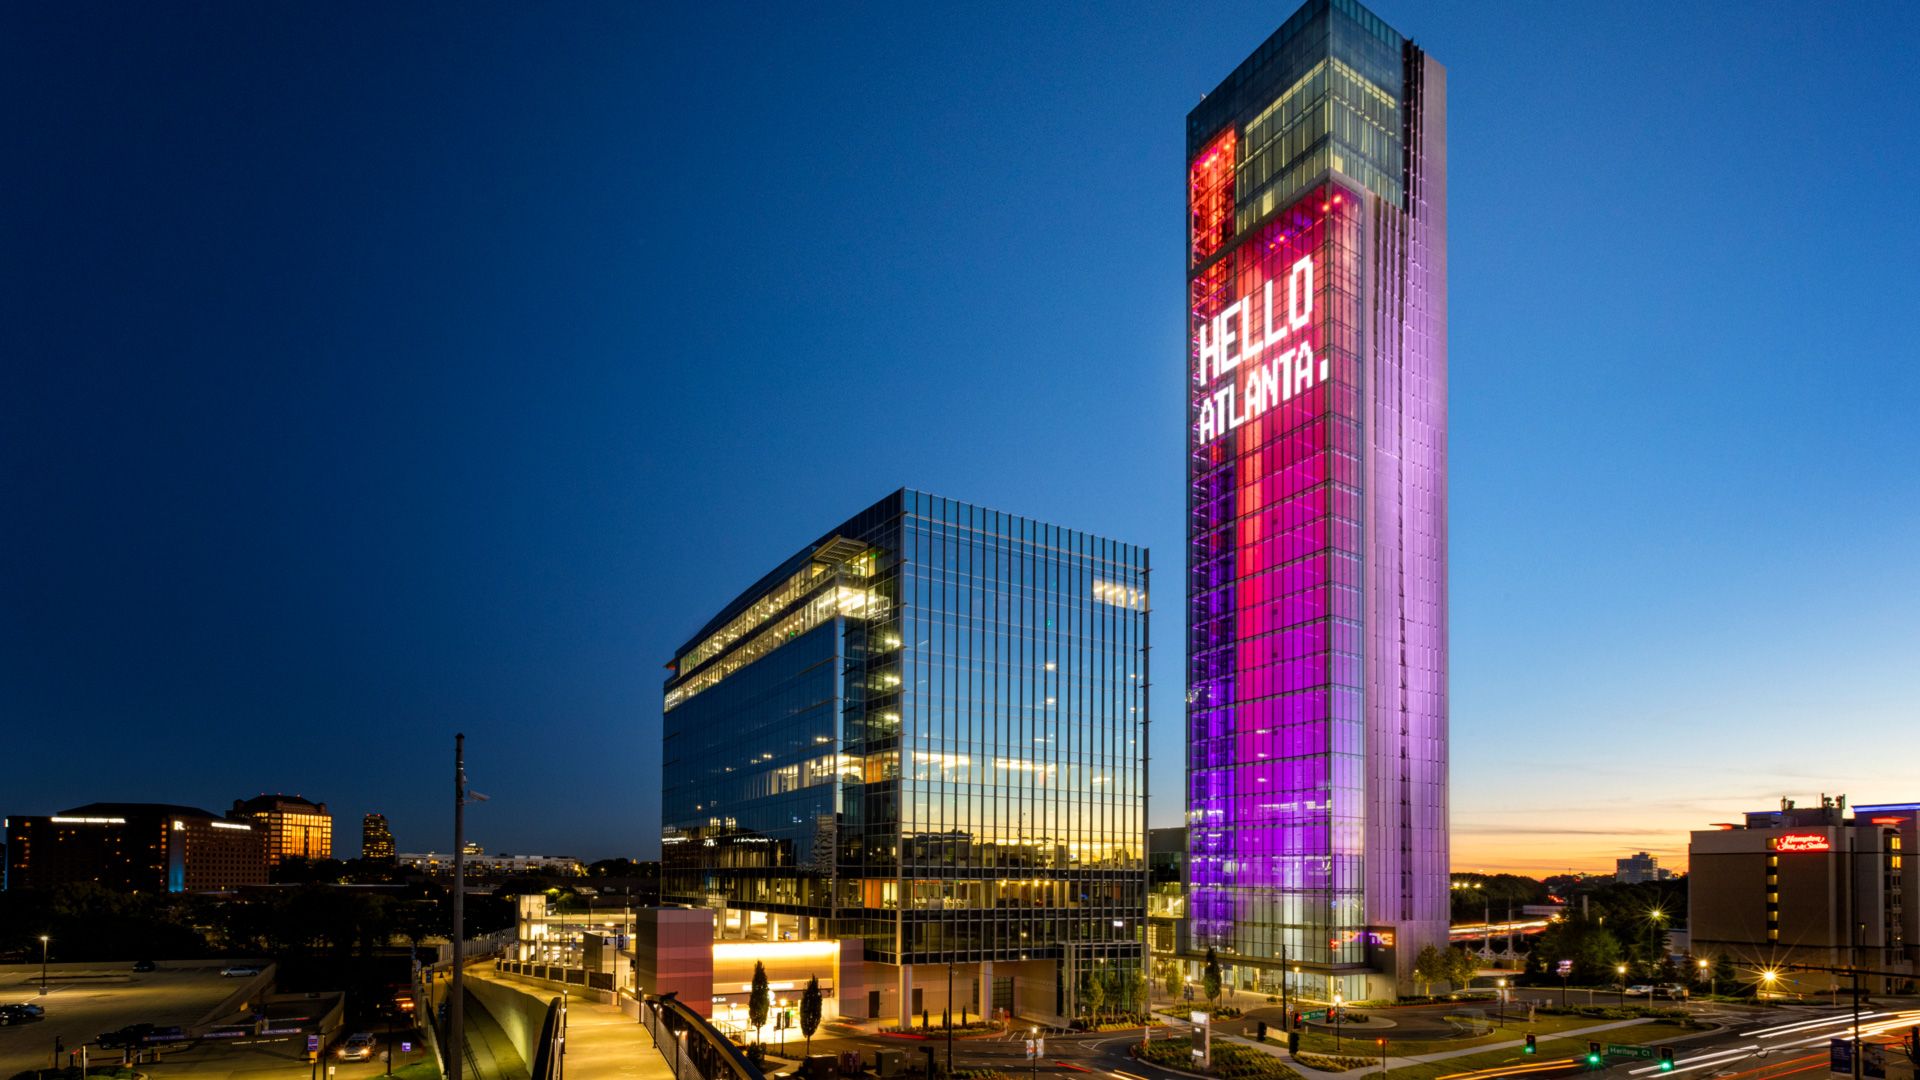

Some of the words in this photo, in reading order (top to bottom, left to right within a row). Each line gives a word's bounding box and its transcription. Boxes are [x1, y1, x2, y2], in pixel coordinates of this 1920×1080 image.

[1200, 254, 1313, 386] HELLO
[174, 821, 185, 830] R
[1780, 835, 1825, 844] Hampton
[1610, 1047, 1639, 1056] Heritage
[1641, 1049, 1650, 1057] Ct
